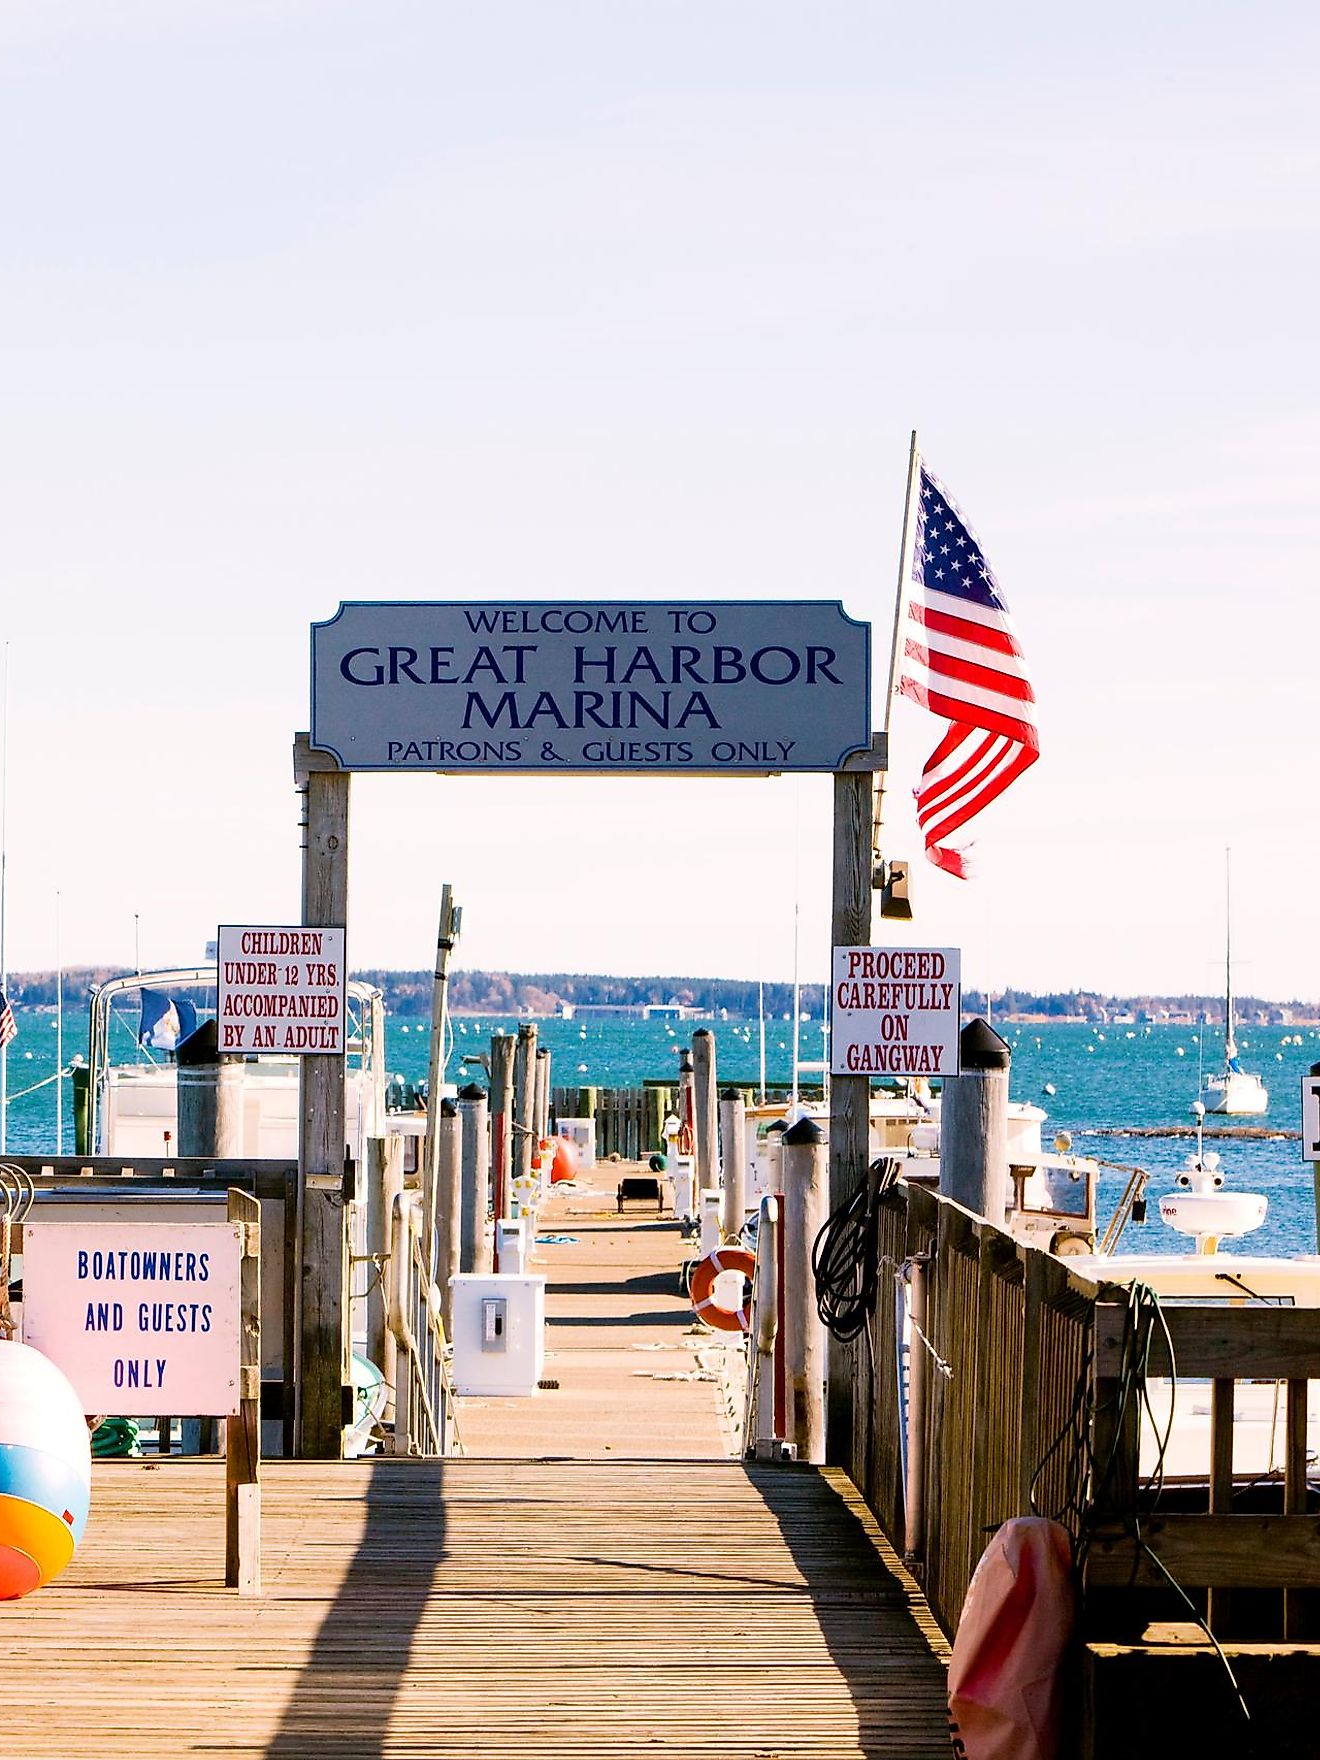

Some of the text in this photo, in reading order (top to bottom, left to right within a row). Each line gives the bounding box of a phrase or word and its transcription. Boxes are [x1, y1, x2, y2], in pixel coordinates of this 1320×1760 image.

[463, 610, 718, 634] WELCOME TO
[339, 645, 844, 686] GREAT HARBOR
[461, 690, 722, 730] MARINA
[387, 740, 796, 763] PATRONS & GUESTS ONLY
[241, 931, 323, 956] CHILDREN
[224, 962, 340, 987] UNDER 12 YRS.
[847, 951, 946, 980] PROCEED
[223, 993, 339, 1018] ACCOMPANIED
[837, 982, 953, 1010] CAREFULLY
[223, 1024, 340, 1049] BY AN ADULT
[880, 1014, 910, 1042] ON
[846, 1043, 944, 1072] GANGWAY
[77, 1250, 210, 1282] BOATOWNERS
[84, 1302, 212, 1333] AND GUESTS
[114, 1359, 167, 1388] ONLY
